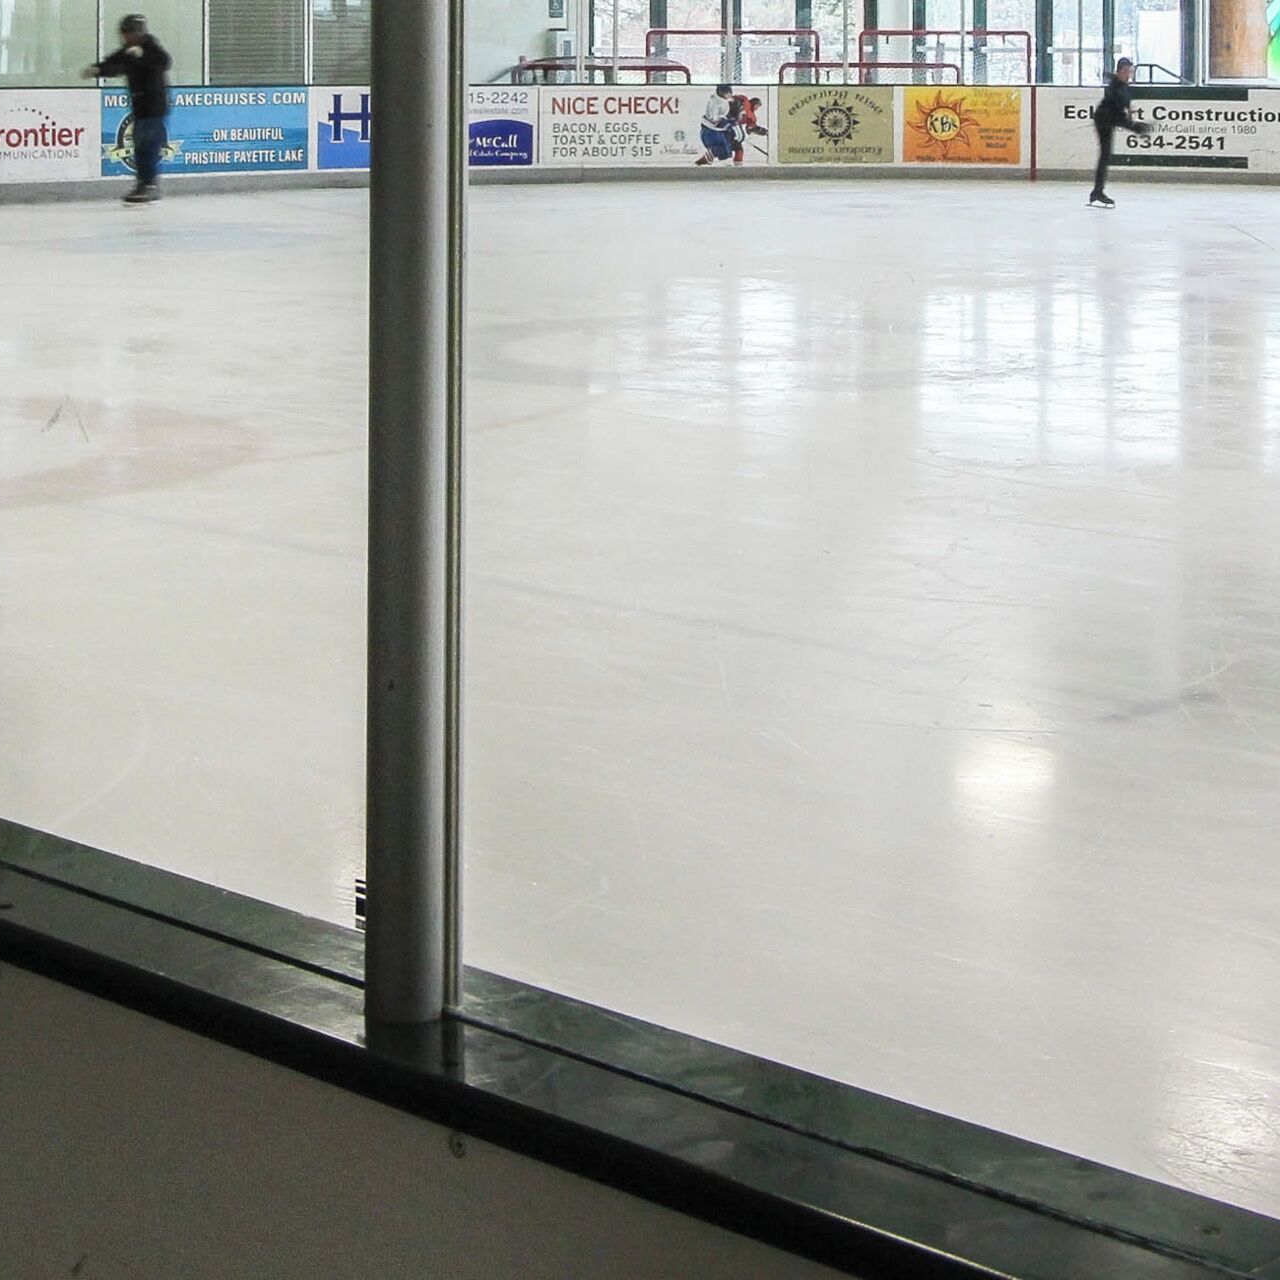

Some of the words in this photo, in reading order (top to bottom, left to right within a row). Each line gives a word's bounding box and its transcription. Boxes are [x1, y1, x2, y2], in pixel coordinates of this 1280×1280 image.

[469, 92, 529, 104] 15-2242
[552, 96, 599, 115] NICE
[604, 96, 680, 114] CHECK!
[230, 127, 285, 141] BEAUTIFUL
[553, 122, 601, 134] BACON,
[605, 122, 642, 134] EGGS,
[1199, 124, 1227, 134] since
[1231, 125, 1257, 134] 1980
[553, 134, 595, 146] TOAST
[598, 134, 606, 145] &
[610, 134, 660, 145] COFFEE
[1126, 135, 1226, 150] 634-2541
[185, 151, 231, 165] PRISTINE
[234, 150, 275, 163] PAYETTE
[278, 149, 304, 162] LAKE
[553, 146, 575, 157] FOR
[584, 146, 626, 157] ABOUT
[631, 145, 653, 158] $15
